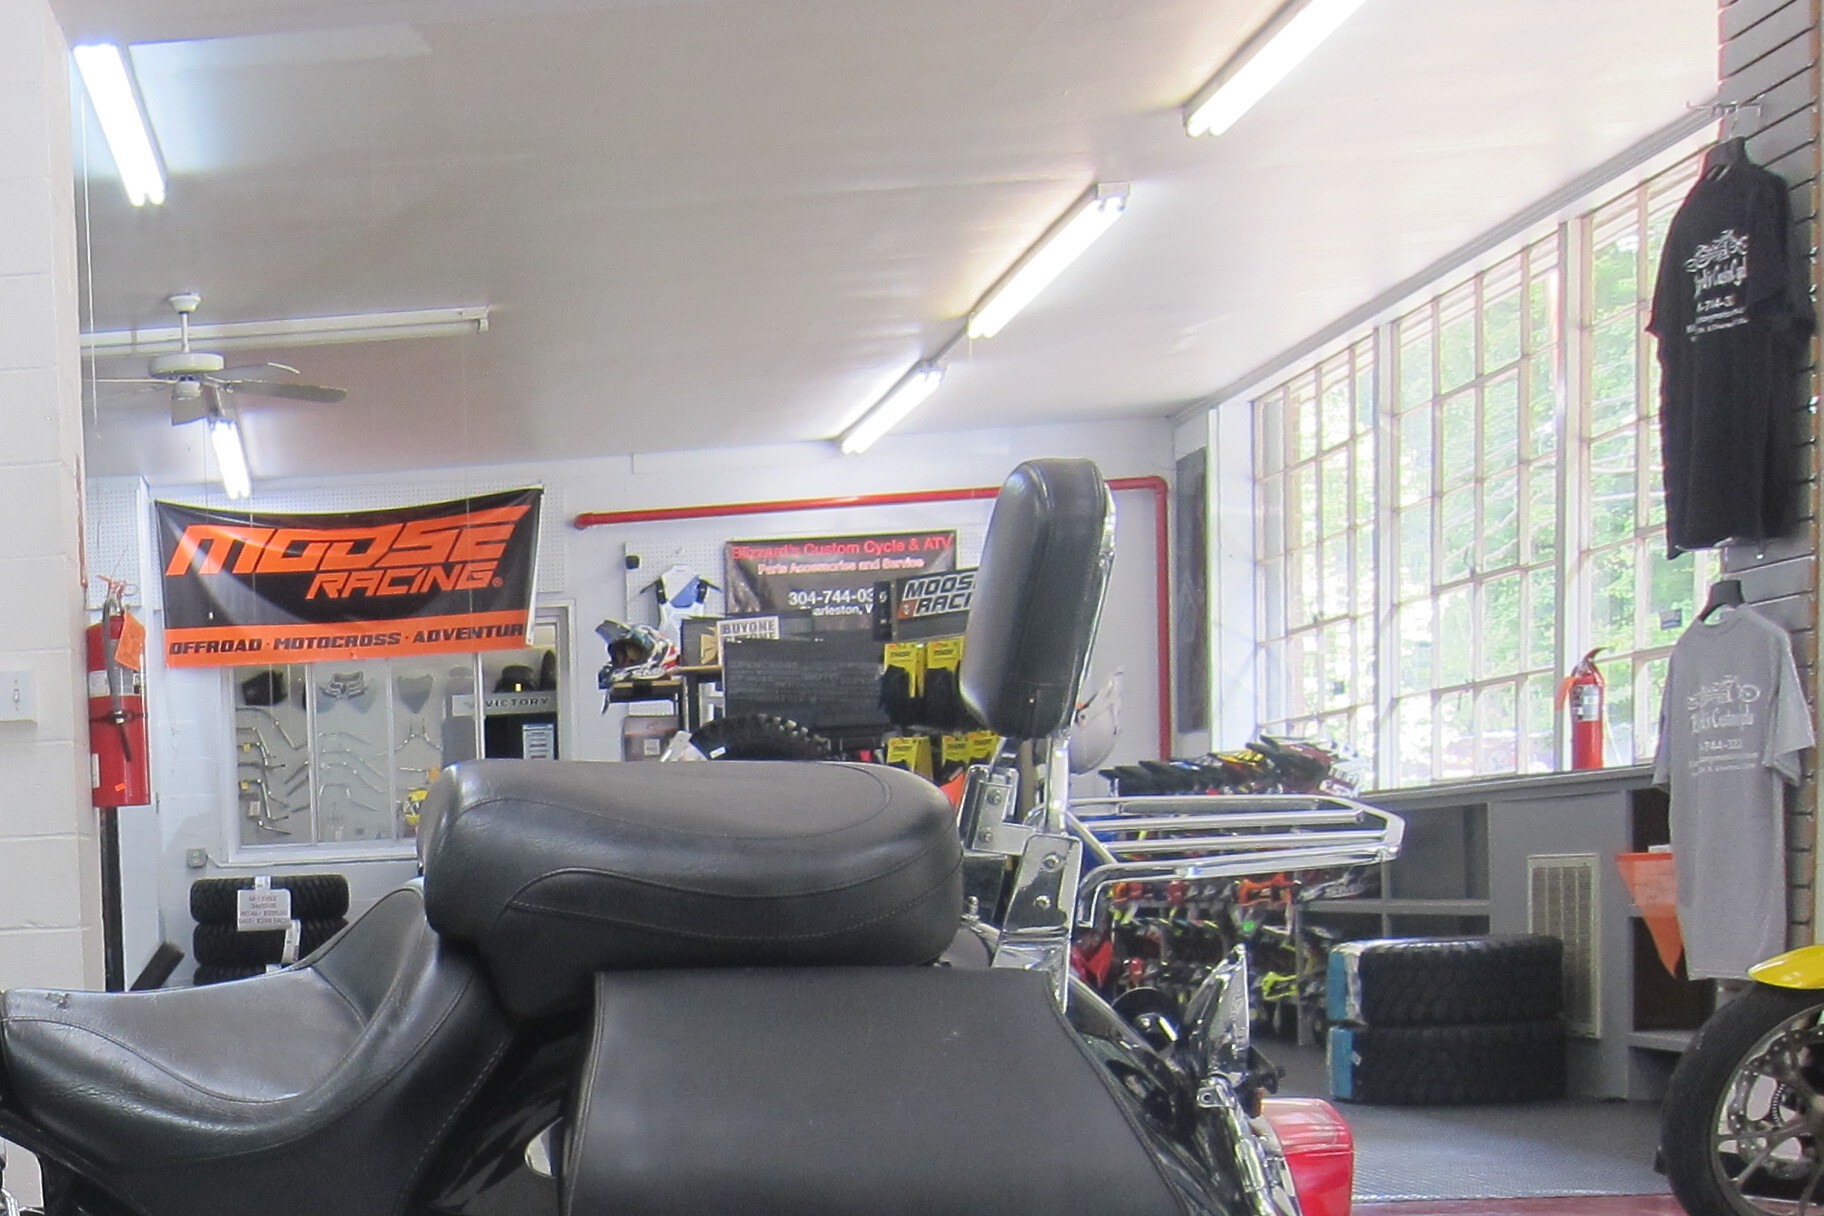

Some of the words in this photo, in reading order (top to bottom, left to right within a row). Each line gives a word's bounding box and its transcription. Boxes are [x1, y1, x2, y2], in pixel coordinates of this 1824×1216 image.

[165, 504, 531, 576] MOOSE
[804, 541, 859, 556] Custom
[863, 539, 905, 555] Cycle
[910, 537, 920, 550] &
[924, 535, 953, 549] ATV
[305, 561, 498, 600] RACING
[905, 573, 975, 599] MOOS
[169, 638, 262, 655] OFFROAD
[273, 632, 401, 650] MOTOCROSS
[486, 697, 549, 708] VICTORY
